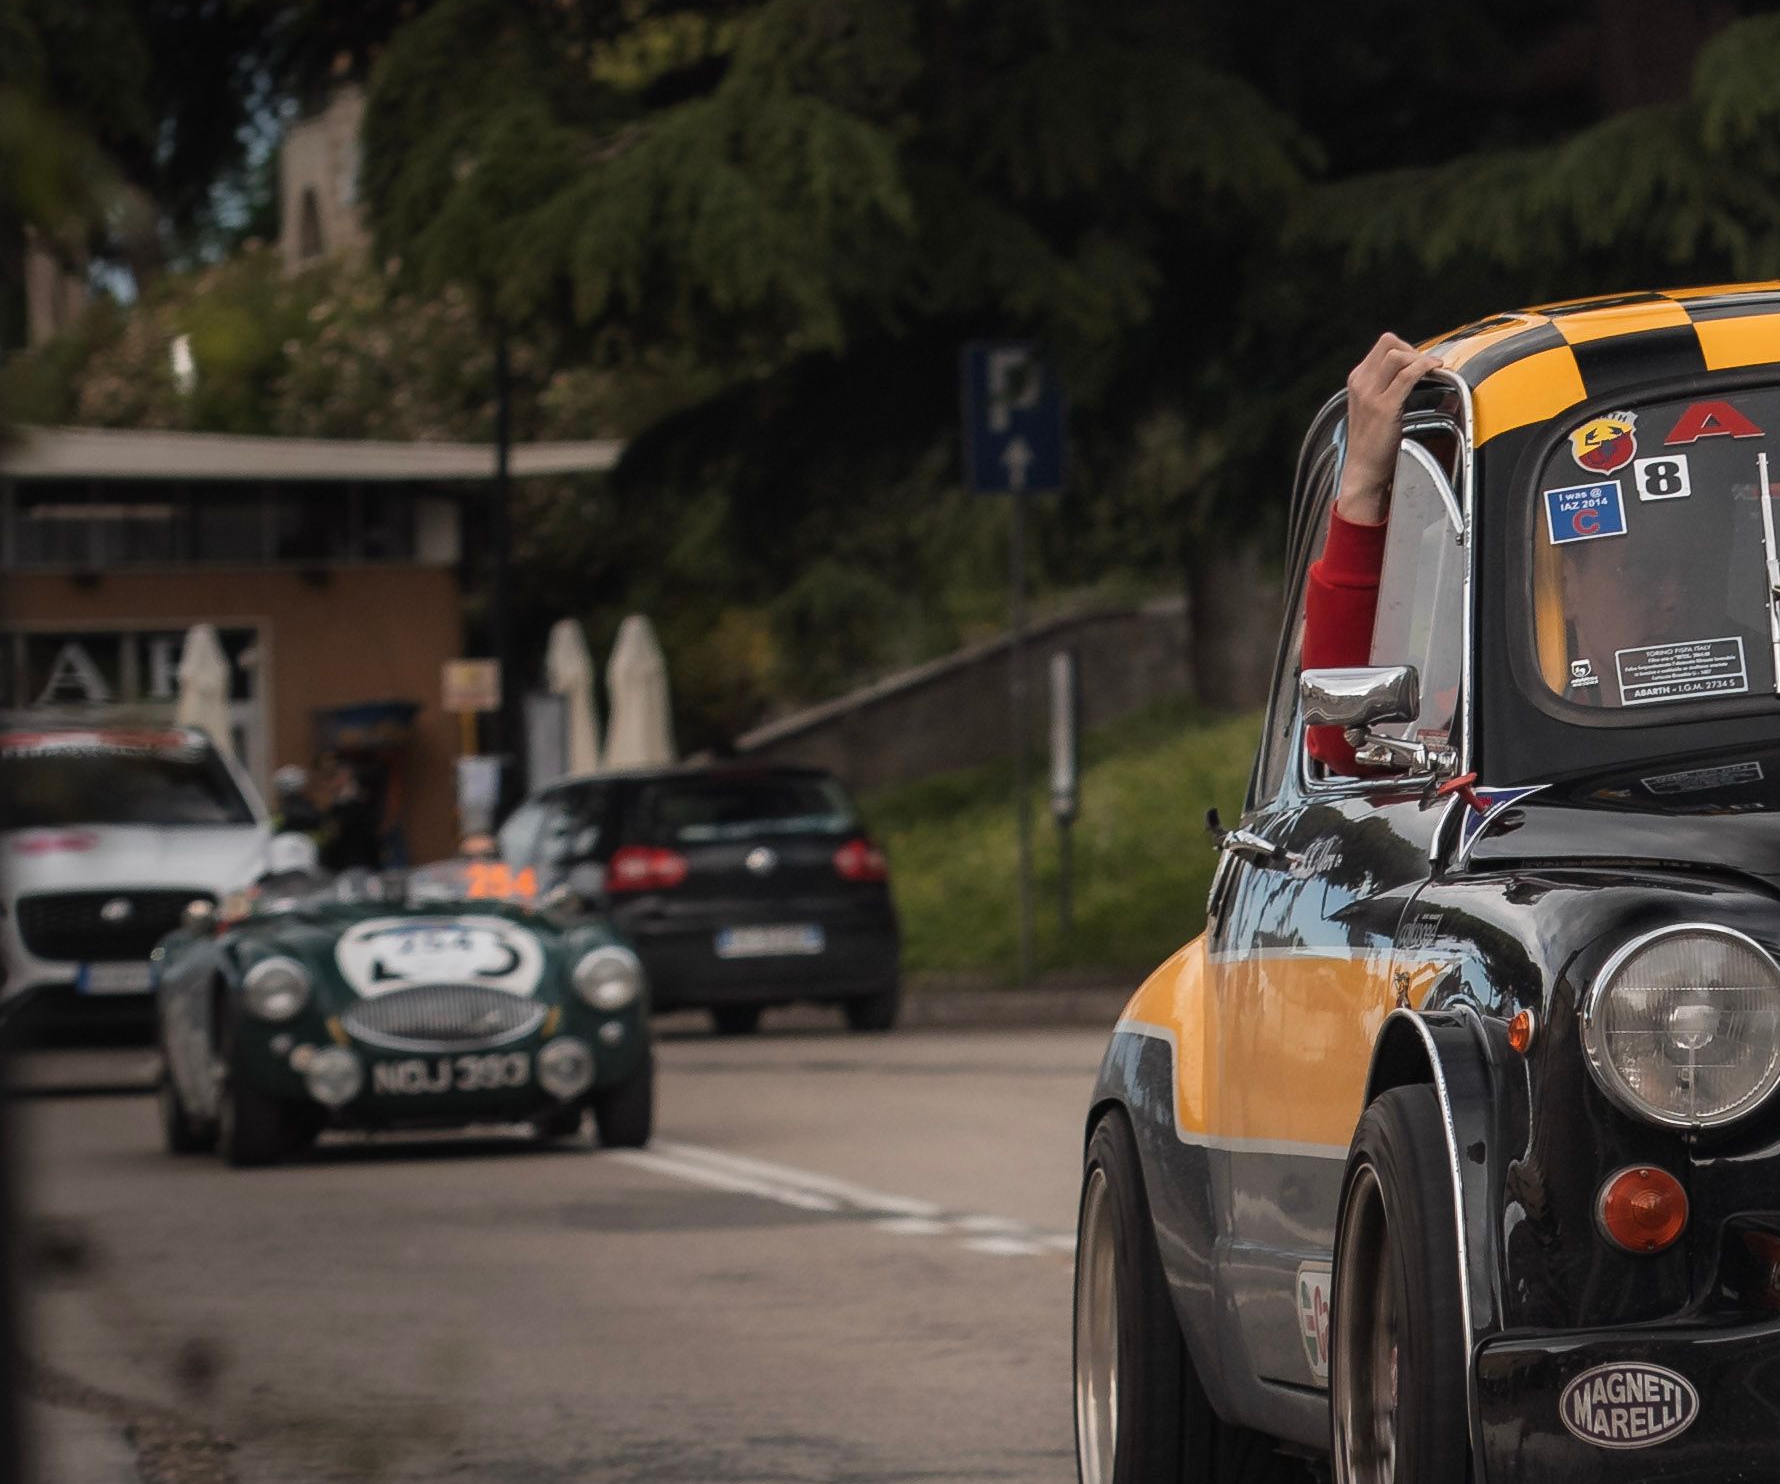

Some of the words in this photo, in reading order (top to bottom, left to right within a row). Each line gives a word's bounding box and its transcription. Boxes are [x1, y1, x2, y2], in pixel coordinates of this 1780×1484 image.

[989, 349, 1040, 432] P
[1644, 461, 1682, 496] 8
[1560, 500, 1580, 512] IAZ
[1582, 497, 1608, 509] 2014
[1566, 490, 1588, 501] was
[1590, 488, 1602, 499] @
[1572, 509, 1600, 535] C
[1634, 685, 1671, 698] ABARTH
[1705, 680, 1728, 690] 2734
[1573, 1372, 1682, 1419] MAGNETI
[1573, 1397, 1682, 1438] MARELLI
